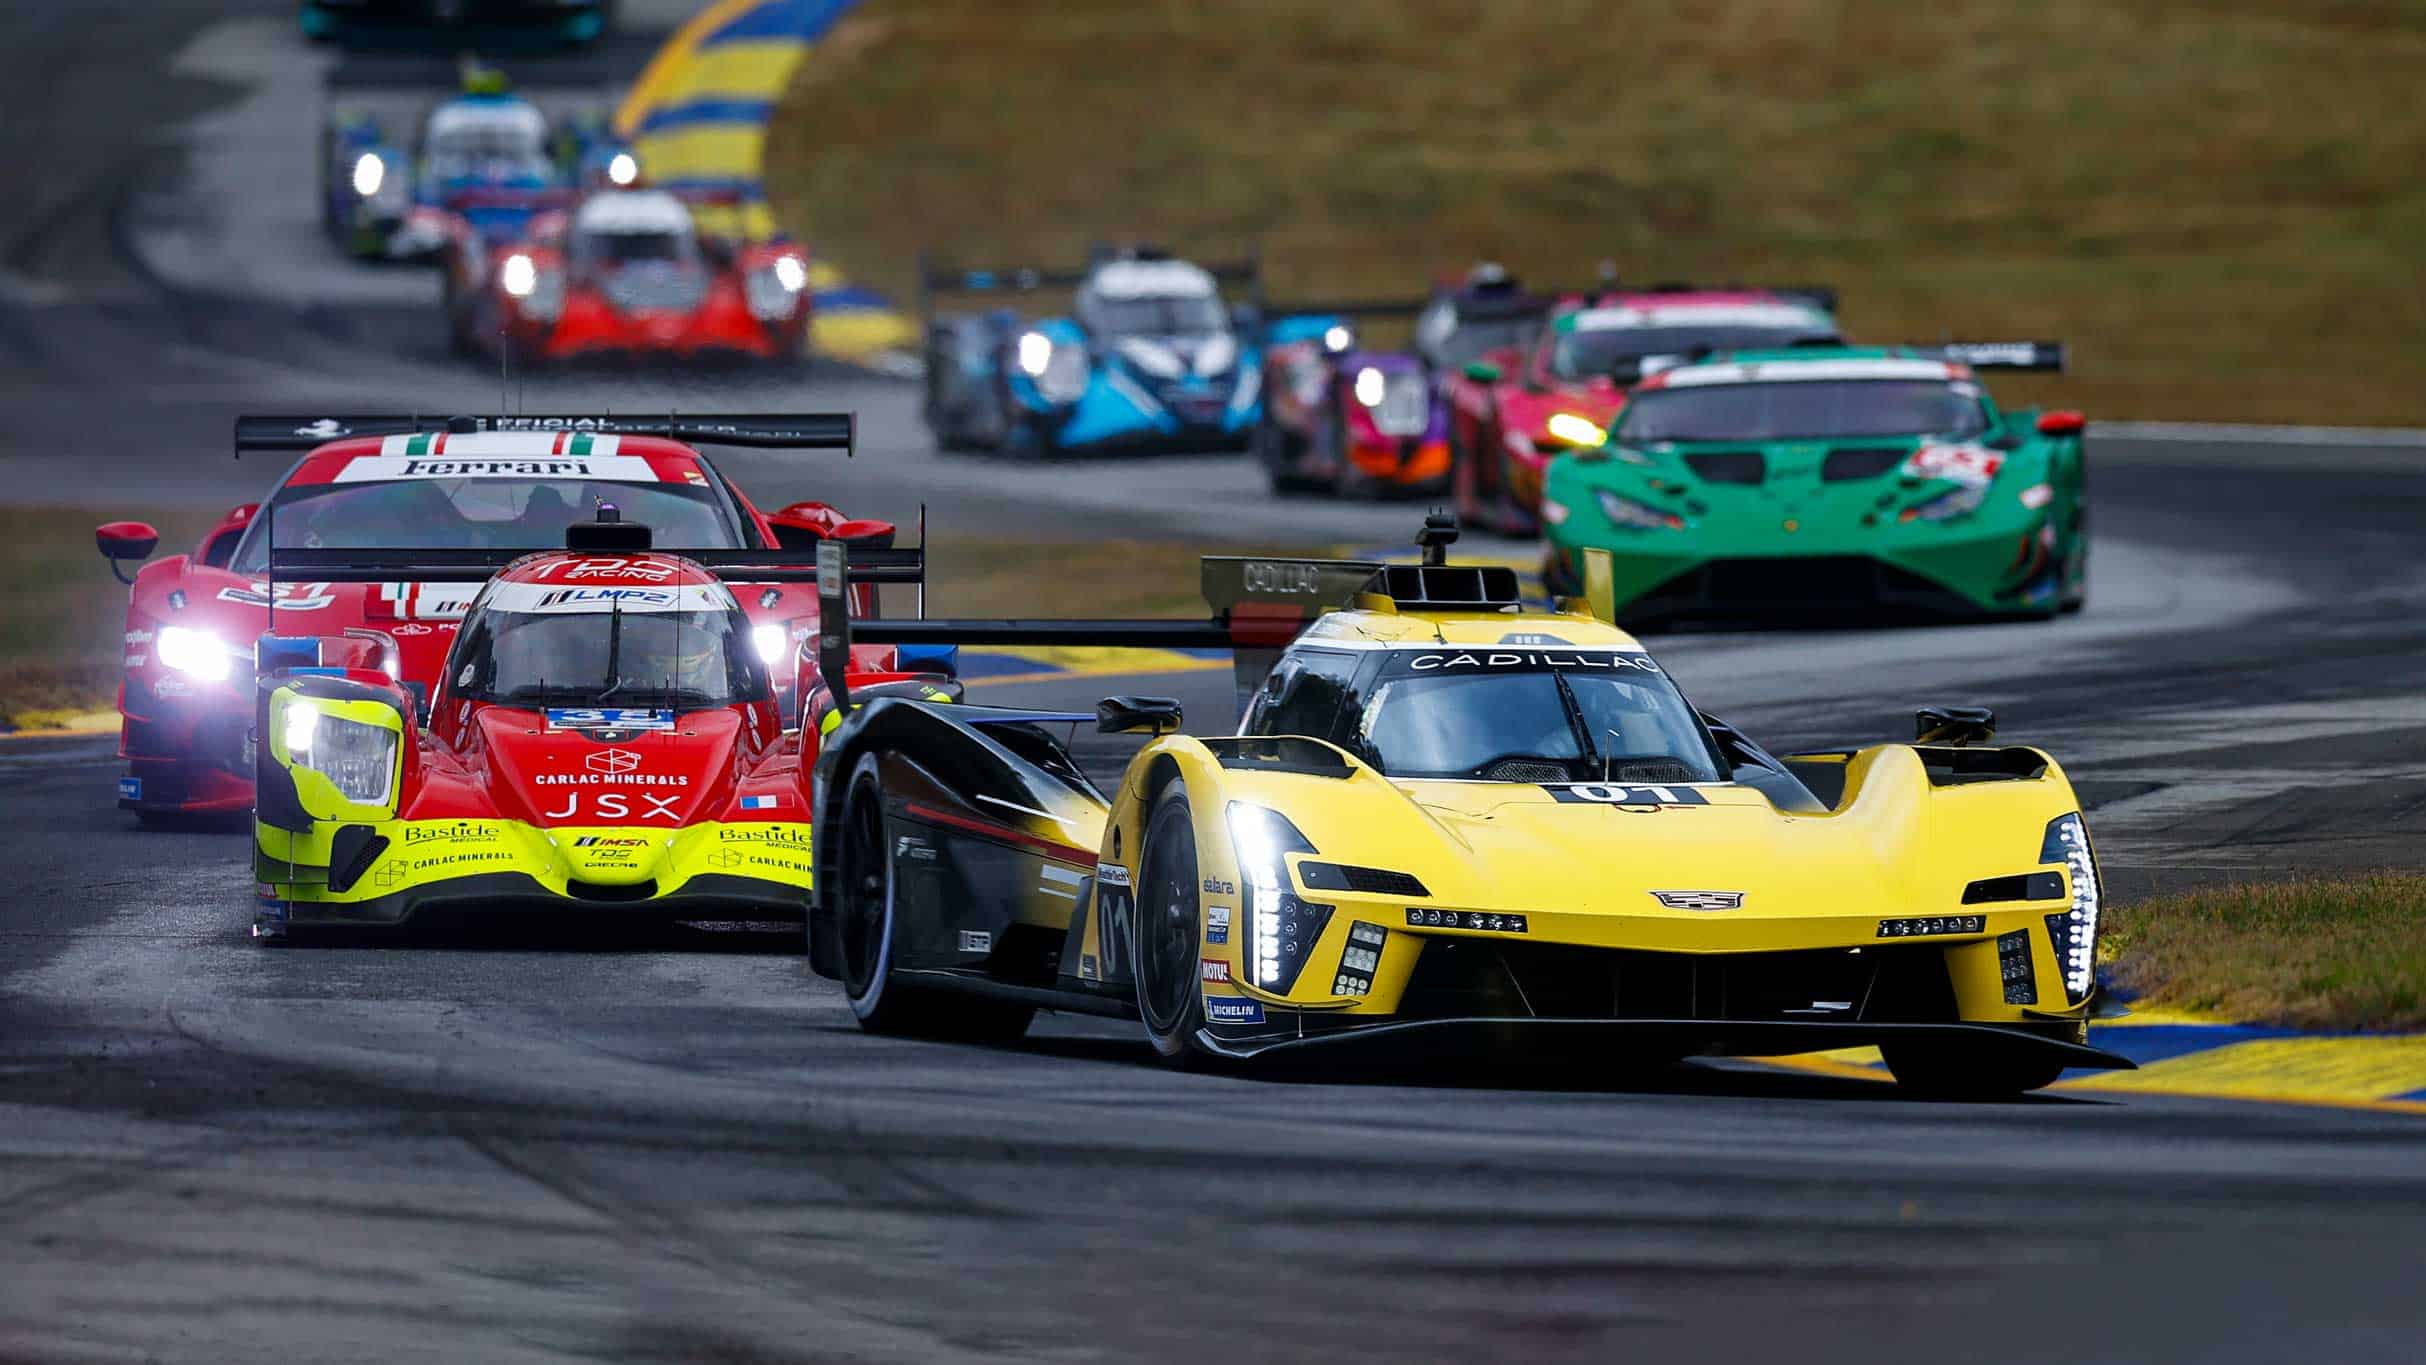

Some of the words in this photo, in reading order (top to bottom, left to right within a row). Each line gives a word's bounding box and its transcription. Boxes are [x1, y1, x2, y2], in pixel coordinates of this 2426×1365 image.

[399, 459, 592, 475] Ferrari
[533, 558, 680, 579] TDS
[574, 589, 670, 603] LMP2
[1410, 653, 1659, 673] CADILLAC
[535, 774, 600, 785] CARLAC
[603, 774, 689, 786] MINERALS
[1569, 785, 1680, 803] 01
[545, 791, 681, 821] JSX
[405, 822, 500, 841] Bastide
[599, 839, 649, 847] IMSA
[413, 855, 456, 870] CARLAC
[458, 852, 513, 861] MINERALS
[749, 855, 792, 869] CARLAC
[1213, 1004, 1255, 1016] MICHELIN
